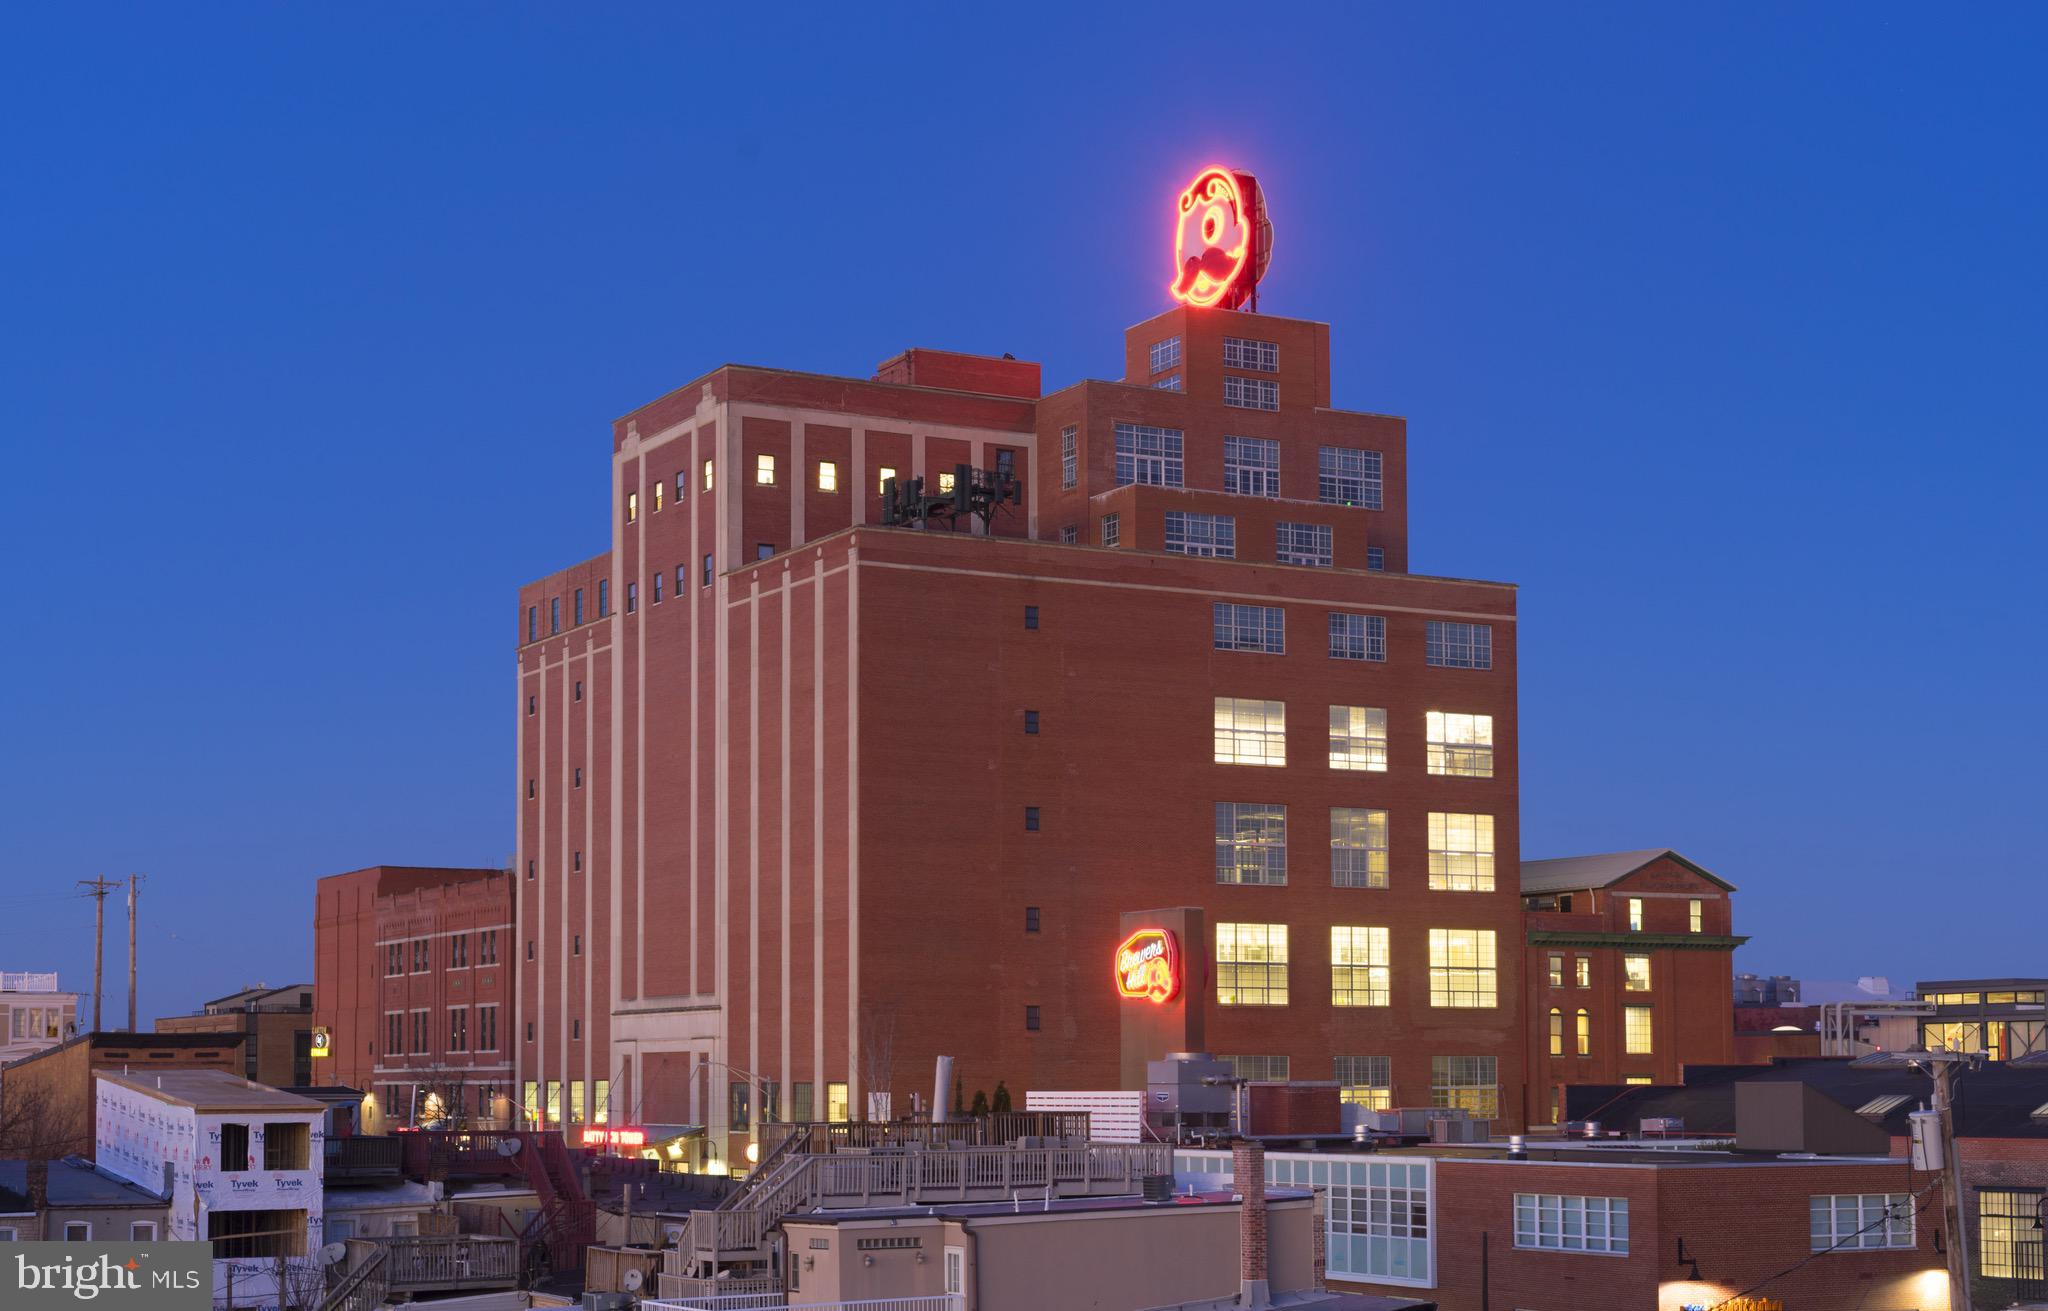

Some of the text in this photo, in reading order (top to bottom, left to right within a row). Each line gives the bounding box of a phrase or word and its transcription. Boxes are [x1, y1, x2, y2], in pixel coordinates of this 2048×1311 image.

[1120, 940, 1163, 973] Brewers
[231, 1180, 258, 1188] Tyvek
[275, 1179, 302, 1187] Tyvek
